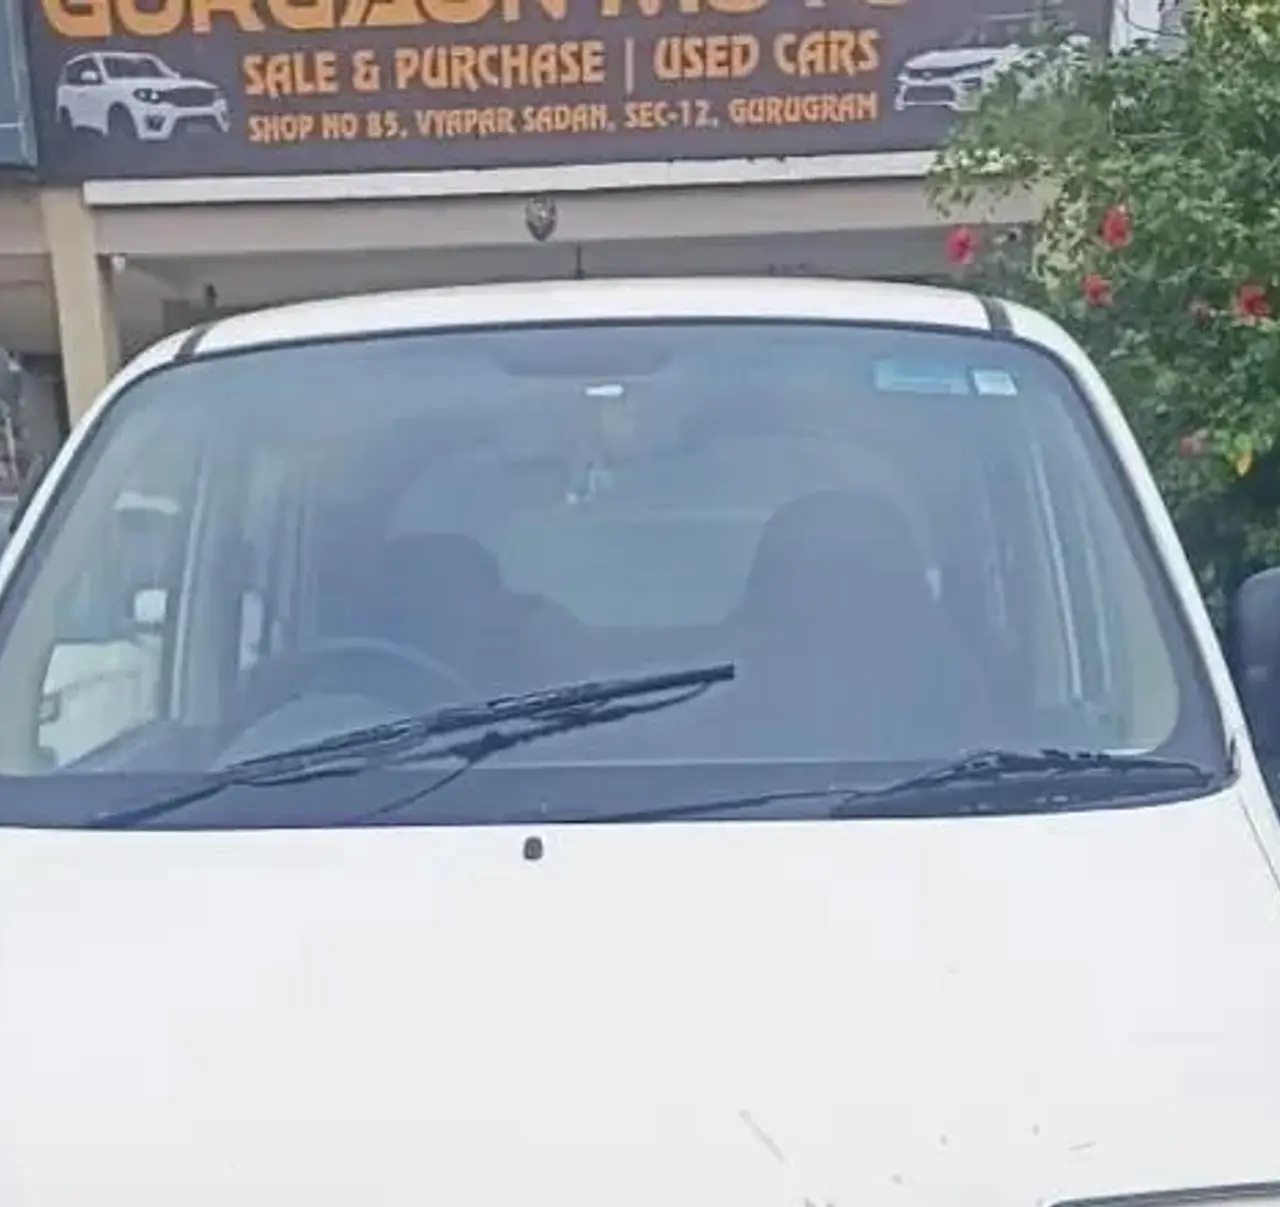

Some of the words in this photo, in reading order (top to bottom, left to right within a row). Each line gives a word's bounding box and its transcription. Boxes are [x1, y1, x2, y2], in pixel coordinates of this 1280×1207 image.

[243, 51, 339, 98] SALE
[352, 50, 380, 91] &
[395, 40, 606, 91] PURCHASE
[653, 34, 760, 79] USED
[773, 28, 880, 76] CARS
[249, 113, 313, 142] SHOP
[322, 111, 358, 139] NO
[416, 106, 516, 136] VYAPAR
[728, 93, 878, 125] GURUGRAM
